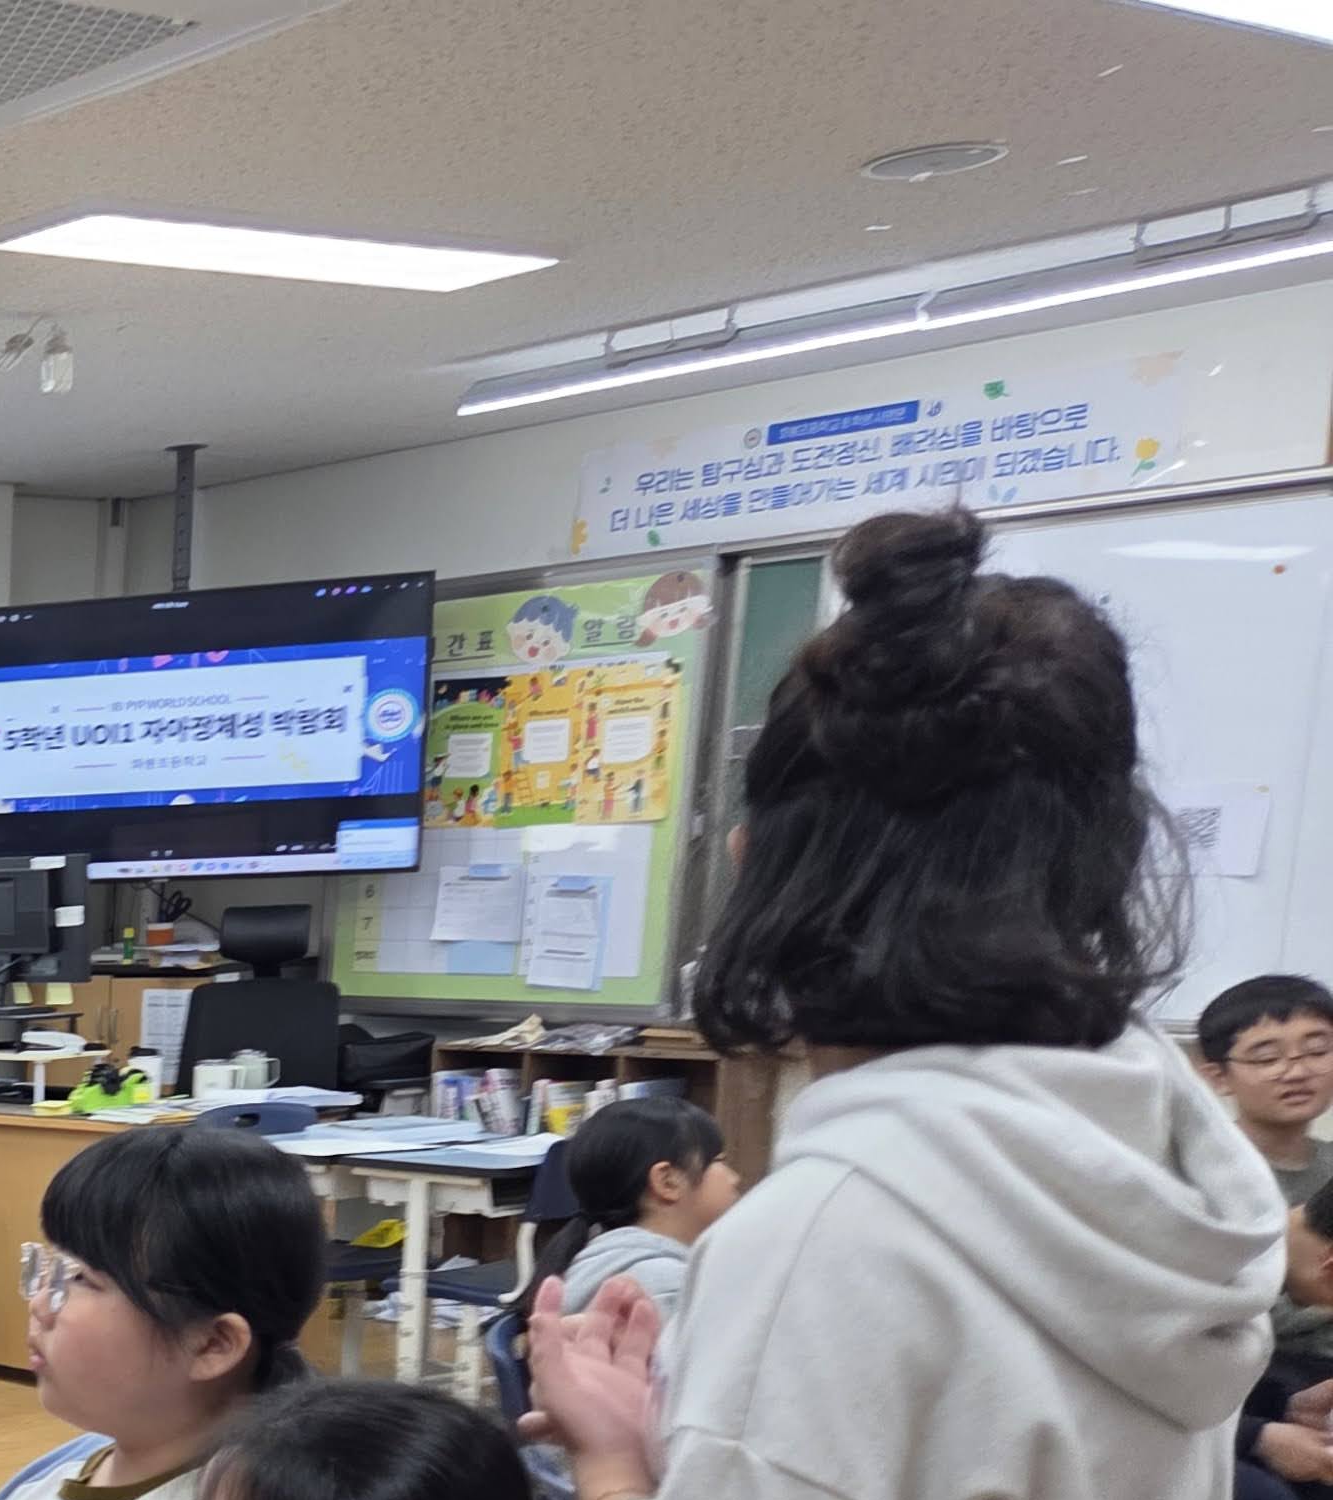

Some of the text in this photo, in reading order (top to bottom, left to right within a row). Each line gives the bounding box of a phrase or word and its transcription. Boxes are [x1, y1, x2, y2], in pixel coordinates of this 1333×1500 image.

[635, 467, 694, 495] 우리는
[701, 449, 786, 486] 탐구심과
[990, 403, 1089, 442] 바탕으로
[610, 508, 629, 533] 더
[634, 501, 676, 527] 나은
[680, 492, 742, 522] 세상을
[747, 477, 857, 513] 만들어가는
[861, 467, 910, 495] 세계
[993, 436, 1121, 478] 되겠습니다.
[3, 725, 66, 752] 5학년
[139, 711, 264, 745] 자아정체성
[269, 705, 348, 737] 박람회
[365, 884, 375, 899] 6
[362, 916, 373, 931] 7
